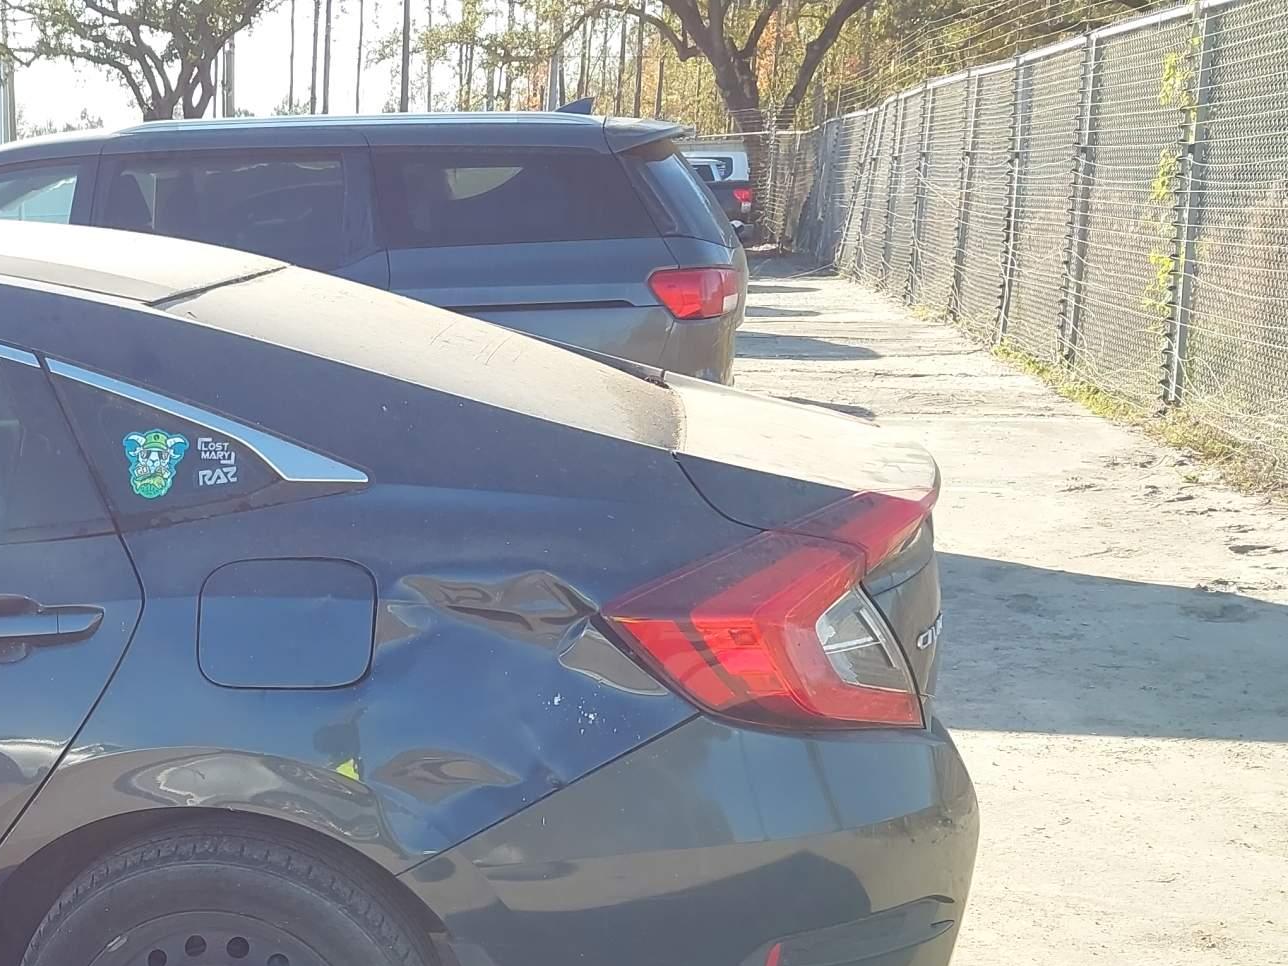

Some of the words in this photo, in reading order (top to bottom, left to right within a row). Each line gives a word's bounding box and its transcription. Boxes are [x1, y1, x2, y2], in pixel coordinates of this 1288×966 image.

[202, 442, 229, 451] LOST
[201, 451, 231, 460] MARY
[198, 466, 237, 486] RAZ
